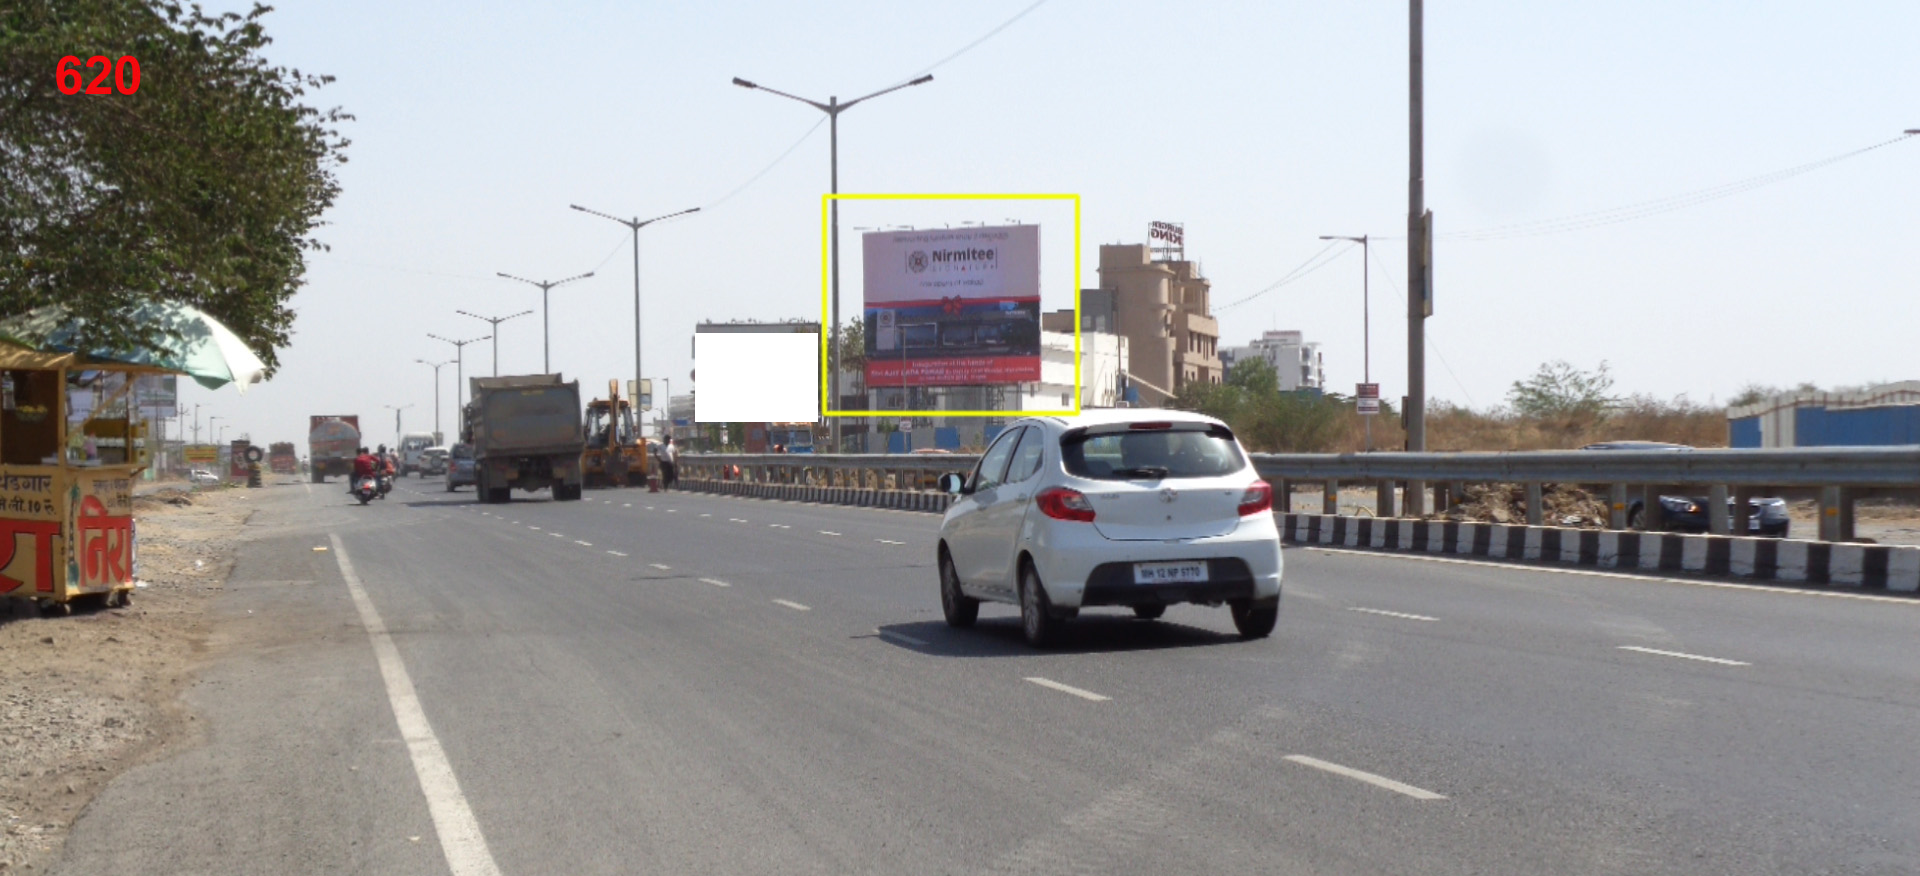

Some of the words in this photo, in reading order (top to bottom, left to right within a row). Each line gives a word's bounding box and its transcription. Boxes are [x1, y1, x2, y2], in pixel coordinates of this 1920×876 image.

[932, 249, 995, 263] Nirmitee
[1141, 569, 1154, 578] MH
[1157, 568, 1165, 578] 12
[1167, 568, 1178, 577] NP
